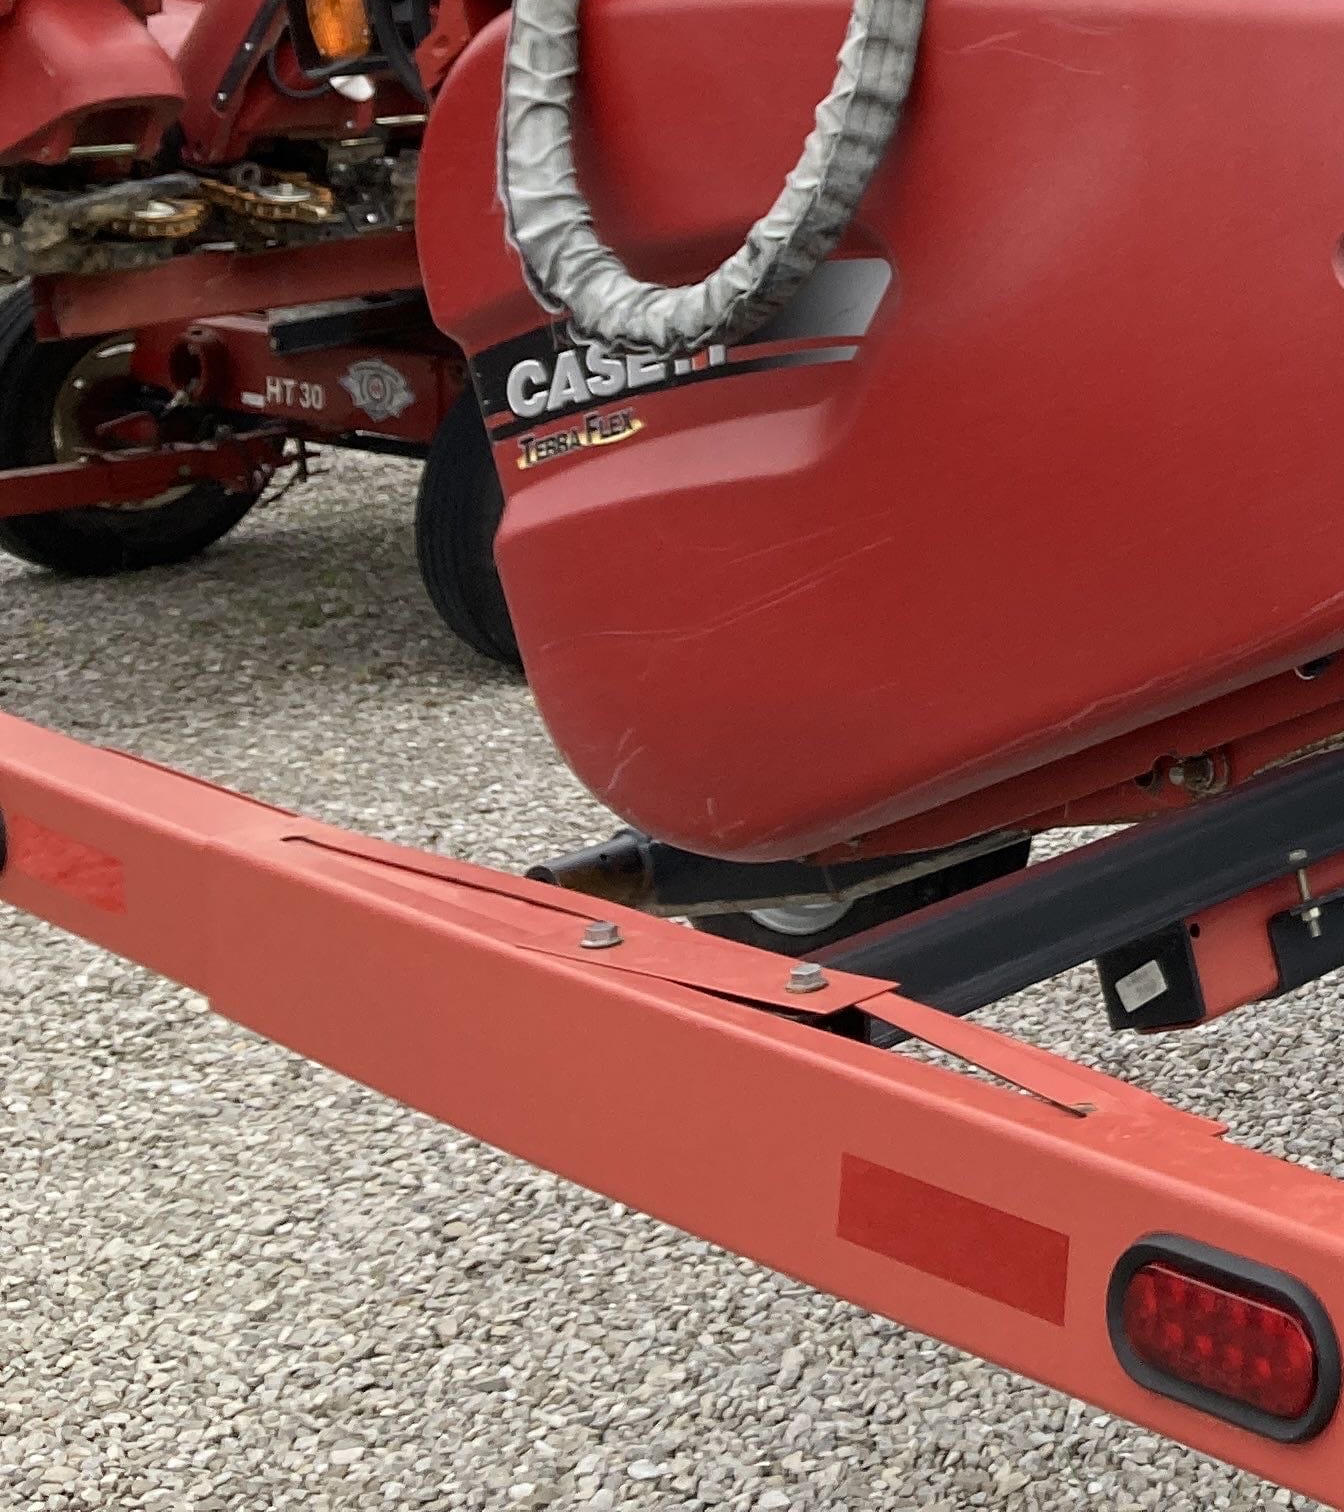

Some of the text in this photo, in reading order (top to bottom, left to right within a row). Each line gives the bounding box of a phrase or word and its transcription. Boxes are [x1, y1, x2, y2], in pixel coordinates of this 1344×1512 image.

[265, 376, 296, 406] HT
[299, 381, 326, 411] 30
[506, 341, 667, 418] CASE
